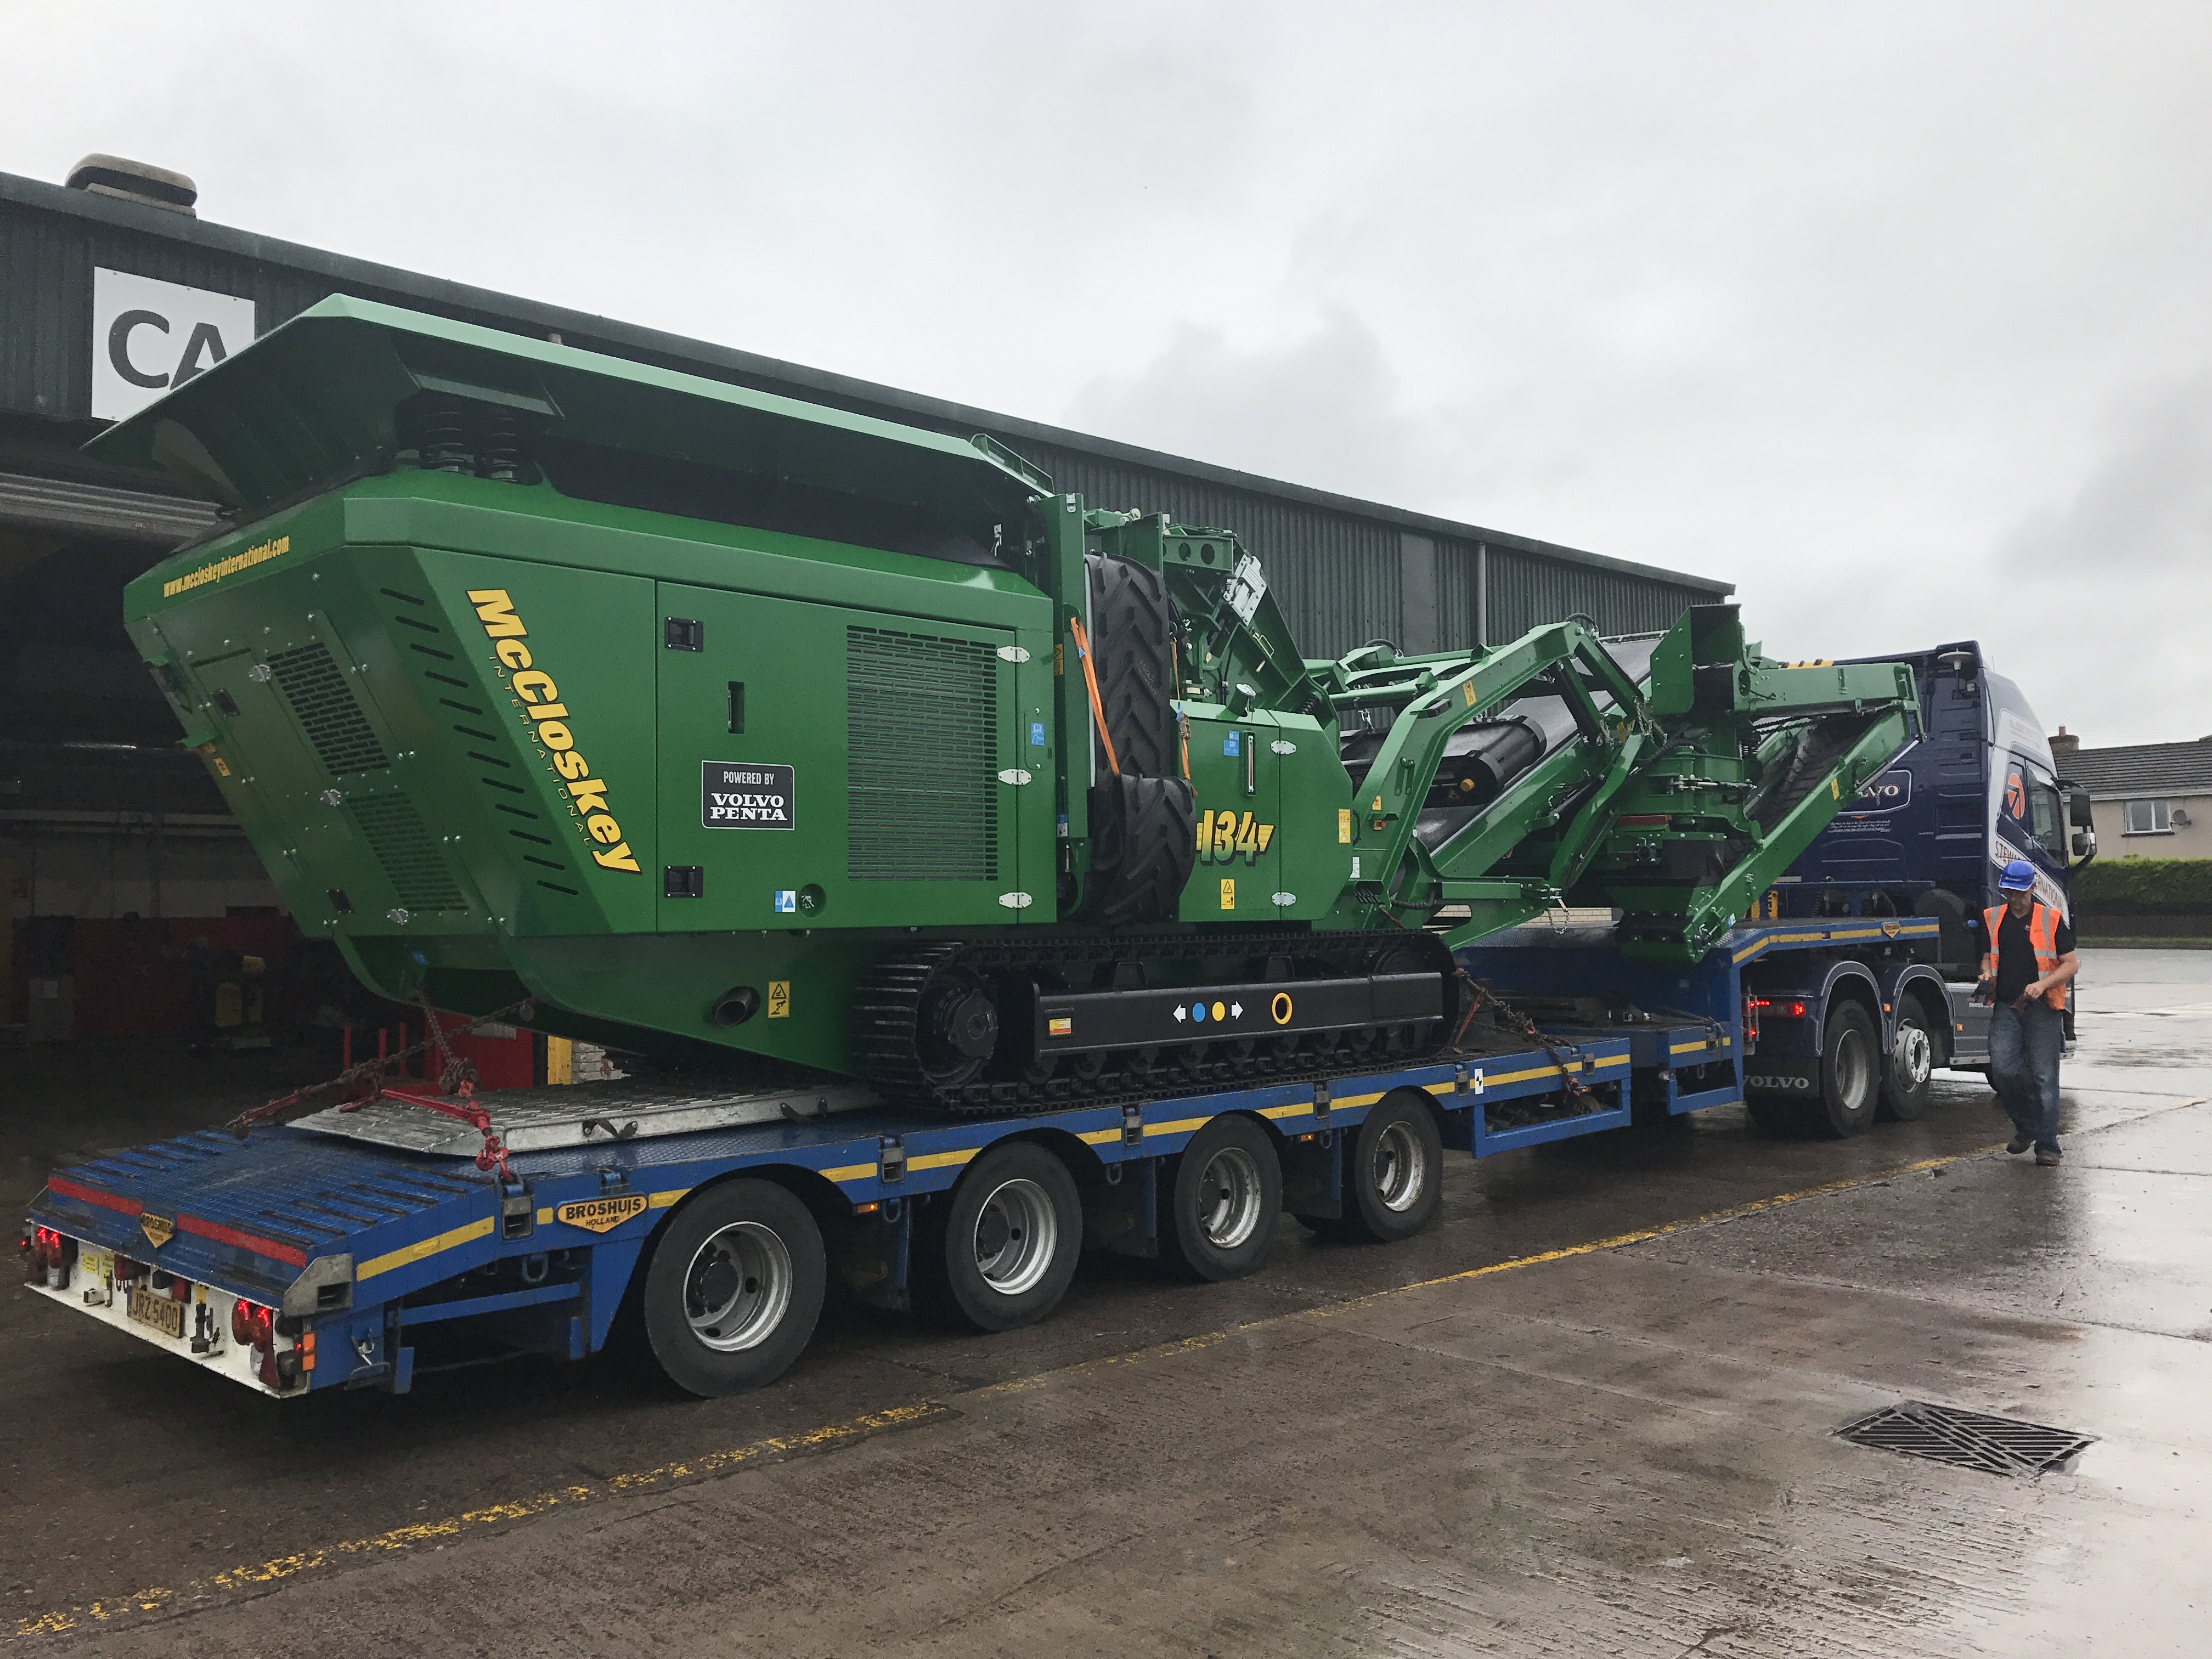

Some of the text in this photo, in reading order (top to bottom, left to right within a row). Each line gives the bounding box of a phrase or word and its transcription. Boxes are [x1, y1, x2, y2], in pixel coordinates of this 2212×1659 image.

[109, 309, 227, 391] CA
[163, 535, 290, 598] www.mccloskeyinternational.com
[465, 588, 643, 875] McCloskey
[488, 656, 591, 847] INTERNATIONAL
[723, 771, 775, 785] POWERED BY
[711, 793, 785, 808] VOLVO
[710, 806, 788, 821] PENTA
[566, 1198, 641, 1221] BROSHUIS
[585, 1216, 620, 1227] HOLLAND
